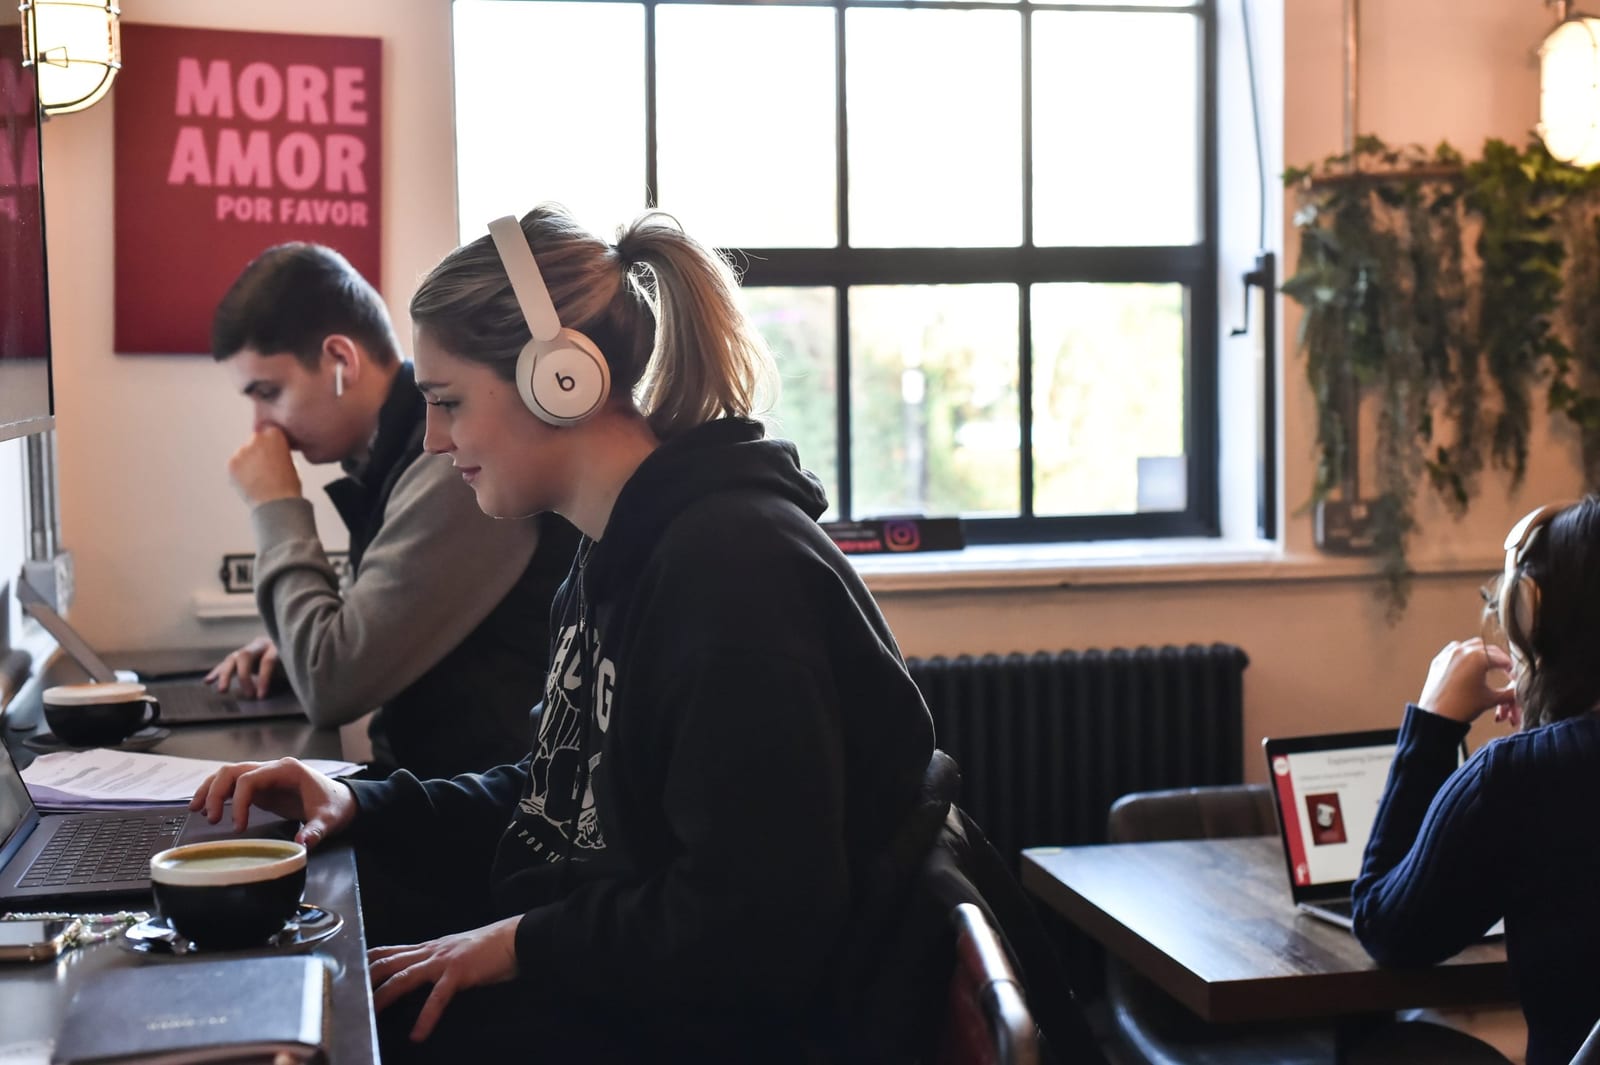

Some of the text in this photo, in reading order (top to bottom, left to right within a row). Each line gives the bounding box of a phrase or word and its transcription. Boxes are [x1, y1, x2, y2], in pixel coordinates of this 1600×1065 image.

[175, 58, 368, 126] MORE
[167, 127, 367, 194] AMOR
[216, 195, 368, 227] POR FAVOR
